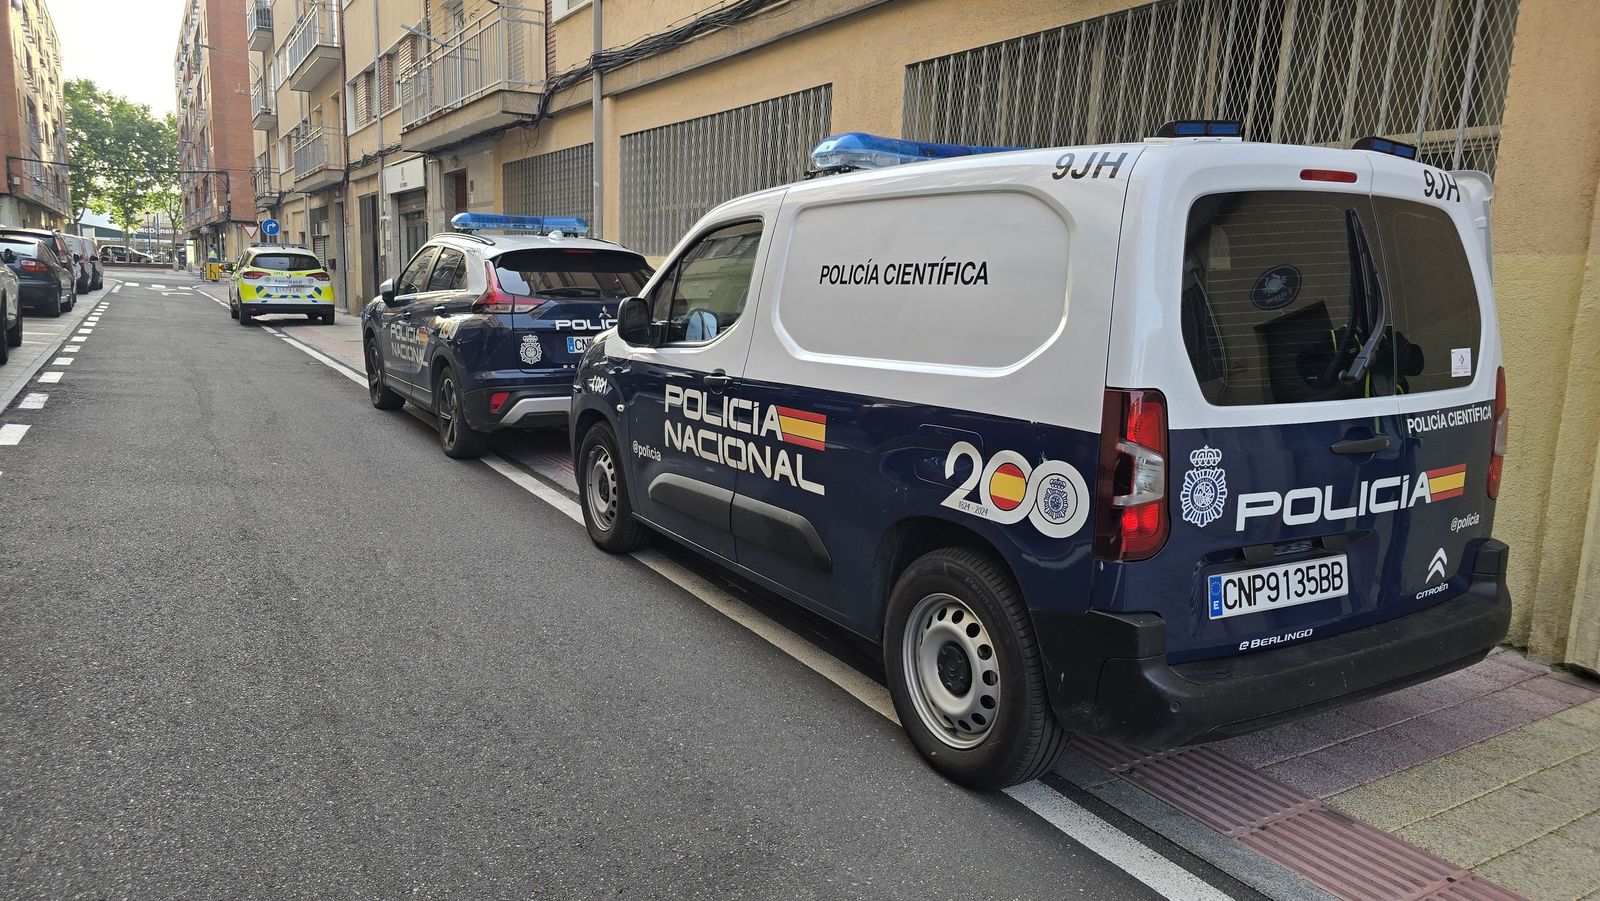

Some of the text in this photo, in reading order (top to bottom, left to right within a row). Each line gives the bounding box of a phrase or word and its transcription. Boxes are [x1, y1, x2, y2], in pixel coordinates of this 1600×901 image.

[1052, 152, 1128, 180] 9JH
[1424, 169, 1460, 202] 9JH
[819, 256, 989, 285] POLICÍA CIENTÍFICA
[555, 319, 619, 331] POLIC
[1406, 404, 1492, 434] POLICÍA CIENTÍFICA
[664, 419, 826, 496] NACIONAL
[1223, 561, 1344, 610] CNP9135BB
[1213, 601, 1220, 610] E
[1250, 628, 1314, 649] BERLINGO
